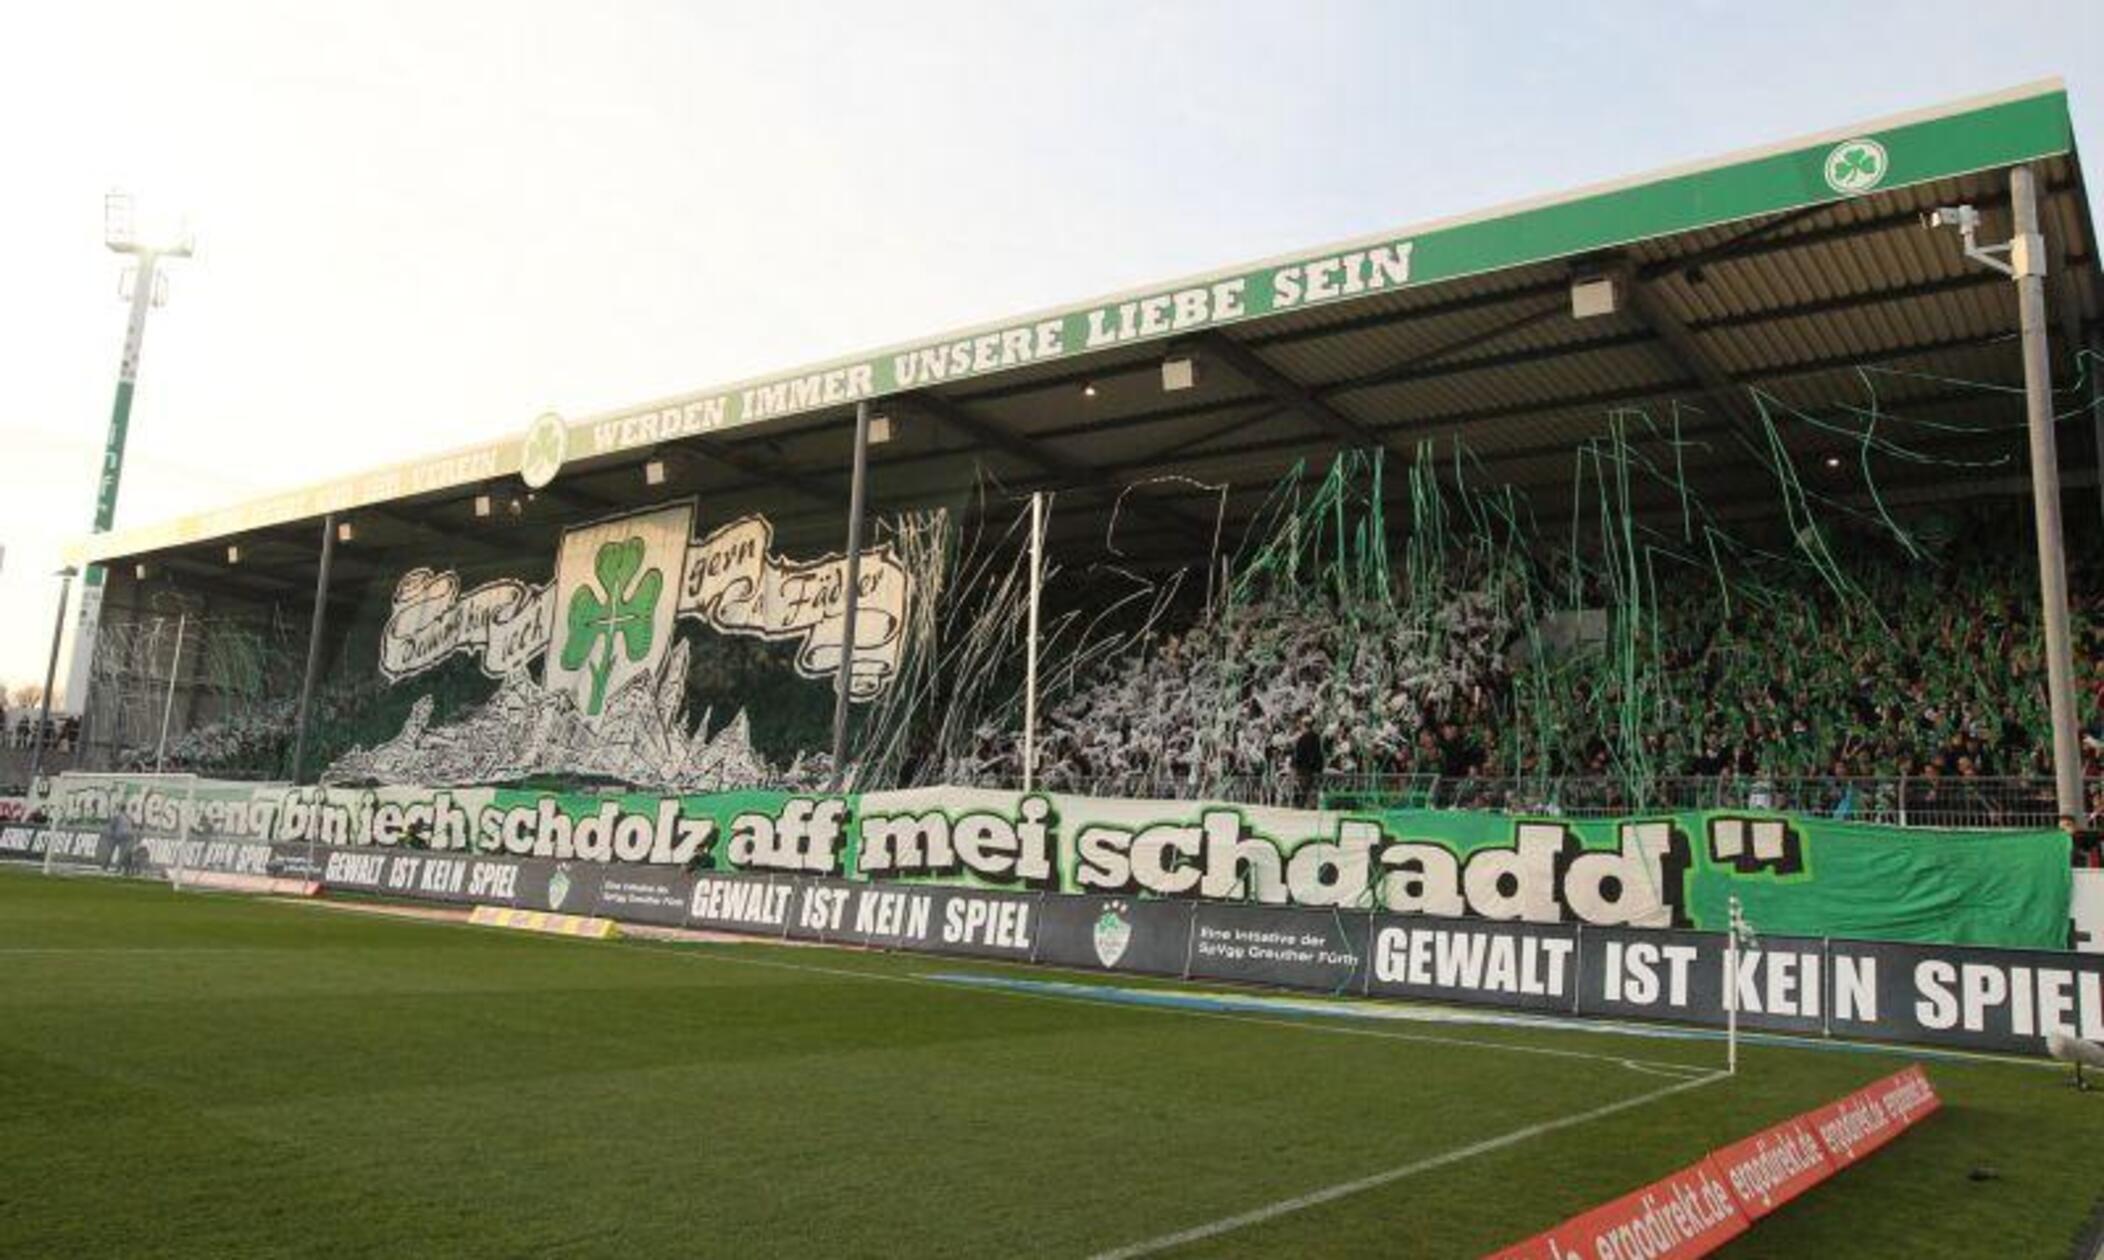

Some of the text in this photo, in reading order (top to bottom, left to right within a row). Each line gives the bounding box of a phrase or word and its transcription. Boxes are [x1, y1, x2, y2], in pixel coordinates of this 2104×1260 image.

[593, 242, 1414, 450] WERDEN IMMER UNSERE LIEBE SEIN
[779, 567, 884, 628] Fäder
[281, 789, 347, 846] bin
[357, 790, 466, 850] iech
[479, 796, 716, 865] schdolz
[728, 798, 846, 872] aff
[859, 796, 1050, 881] mei
[1077, 810, 1673, 929] schdadd
[325, 851, 386, 885] GEWALT
[389, 855, 420, 888] IST
[420, 859, 467, 895] KEIN
[467, 862, 519, 898] SPIEL
[690, 878, 793, 924] GEWALT
[799, 884, 850, 930] IST
[854, 889, 932, 940] KEIN
[942, 897, 1030, 949] SPIEL
[1300, 932, 1327, 947] der
[1374, 927, 2104, 1043] GEWALT IST KEIN SPIEL
[1595, 1171, 1735, 1260] ergodirekt.de
